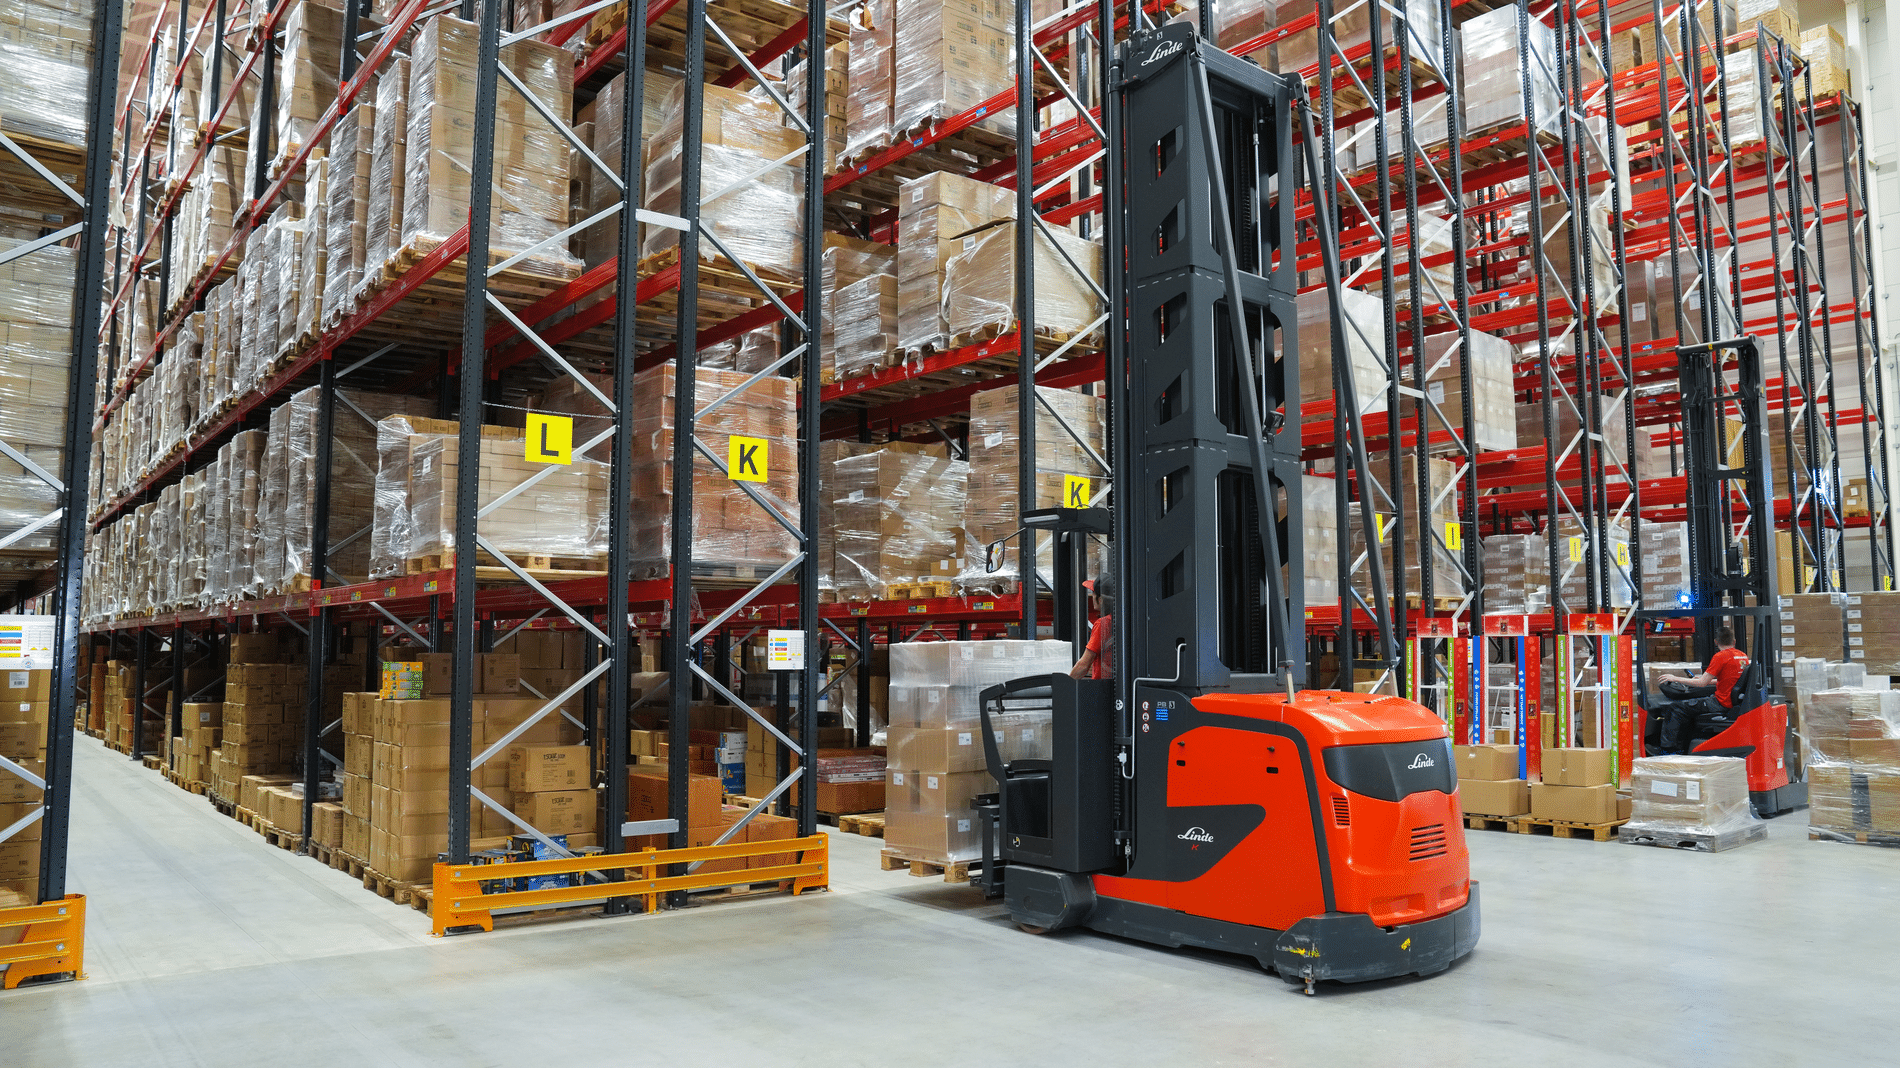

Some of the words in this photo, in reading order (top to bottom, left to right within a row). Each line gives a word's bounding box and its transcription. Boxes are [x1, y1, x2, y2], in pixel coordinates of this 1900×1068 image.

[1140, 40, 1183, 67] Linde
[541, 423, 559, 457] L
[739, 443, 759, 476] K
[1070, 481, 1083, 508] K
[1407, 752, 1435, 770] Linde
[1177, 826, 1214, 843] Linde
